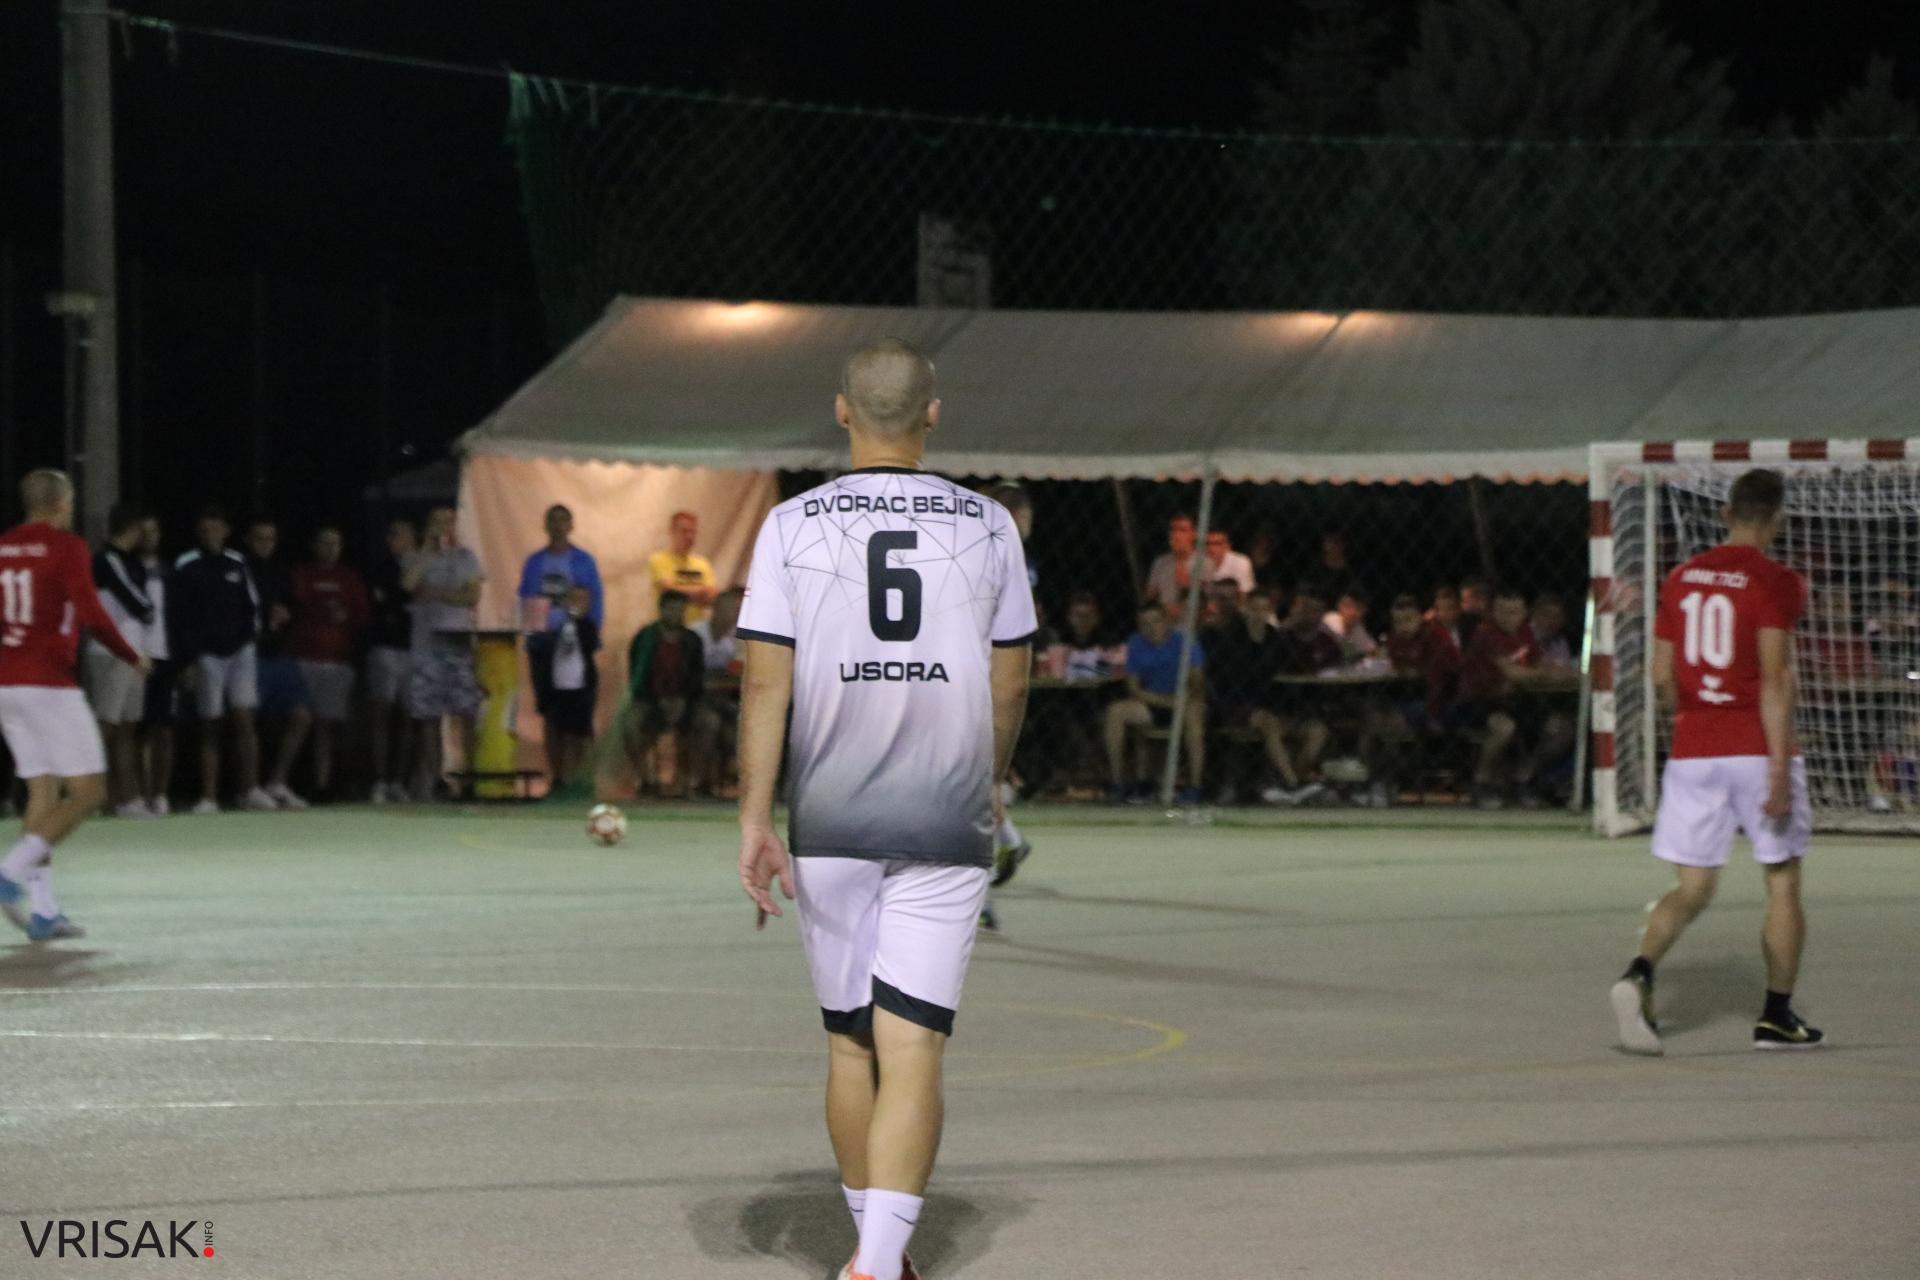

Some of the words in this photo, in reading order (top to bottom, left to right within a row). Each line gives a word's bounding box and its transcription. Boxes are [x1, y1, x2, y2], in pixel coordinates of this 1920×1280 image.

[804, 495, 907, 518] DVORAC
[0, 568, 33, 625] 11
[867, 530, 922, 642] 6
[1679, 591, 1735, 669] 10
[840, 662, 950, 683] USORA
